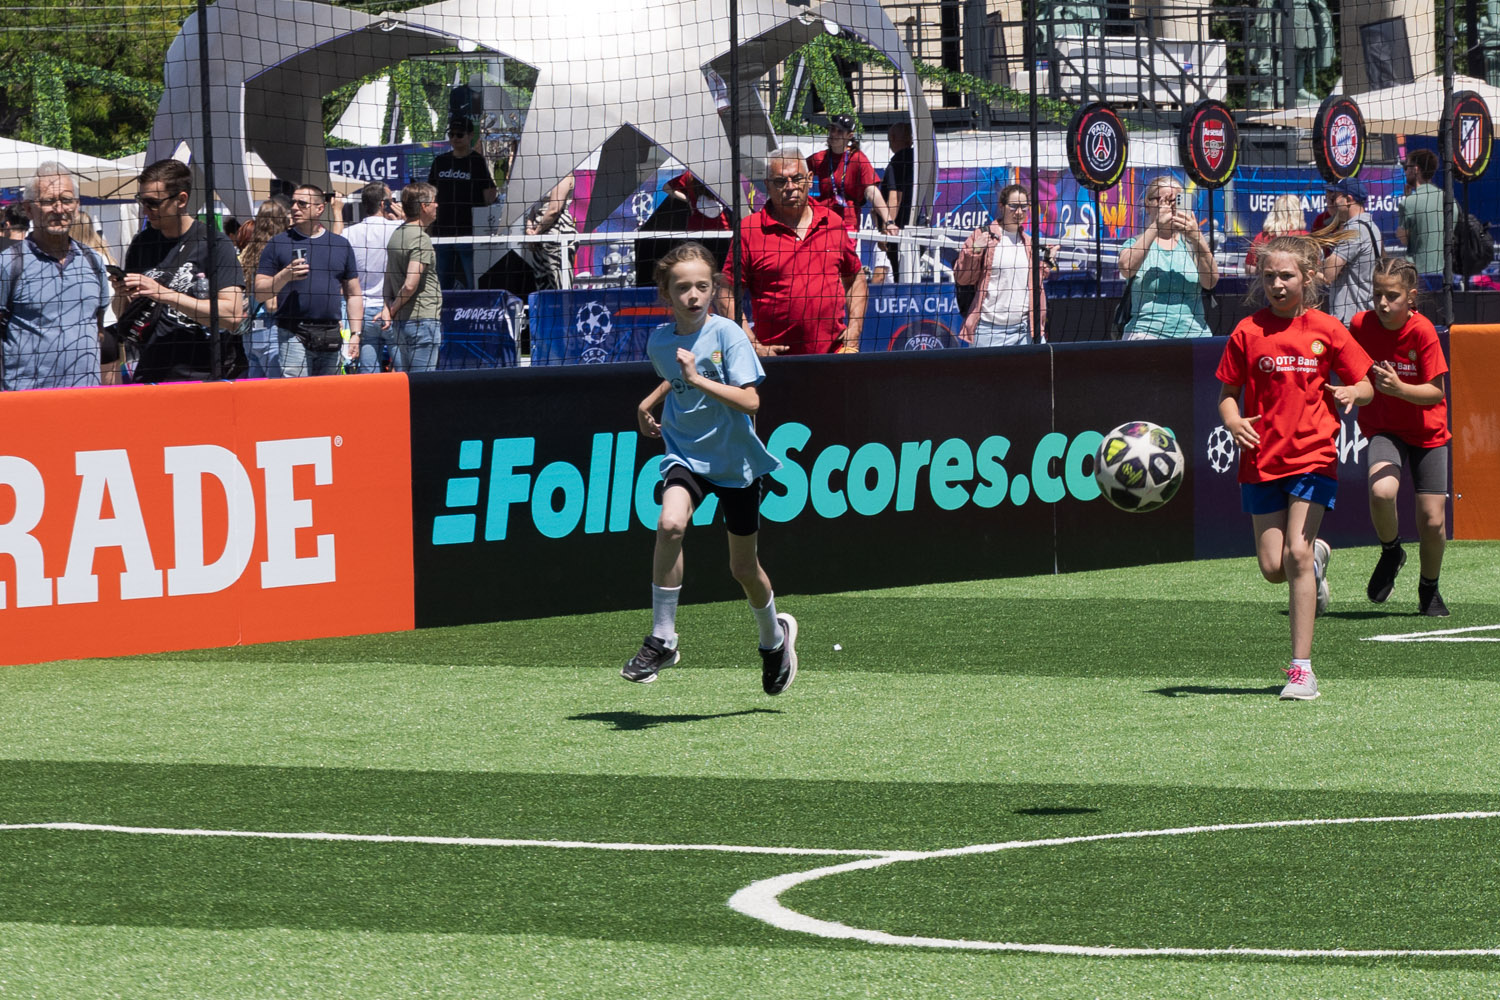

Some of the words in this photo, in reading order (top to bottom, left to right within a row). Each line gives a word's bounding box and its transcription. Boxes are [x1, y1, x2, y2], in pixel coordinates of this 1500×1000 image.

[1090, 124, 1112, 137] PARIS
[1204, 128, 1224, 137] Arsenal
[329, 156, 399, 181] ERAGE
[438, 169, 471, 180] adidas
[1250, 195, 1275, 212] UEF
[936, 211, 989, 230] LEAGUE
[875, 297, 919, 314] UEFA
[1276, 356, 1296, 366] OTP
[1298, 356, 1318, 367] Bank
[1398, 362, 1417, 371] Bank
